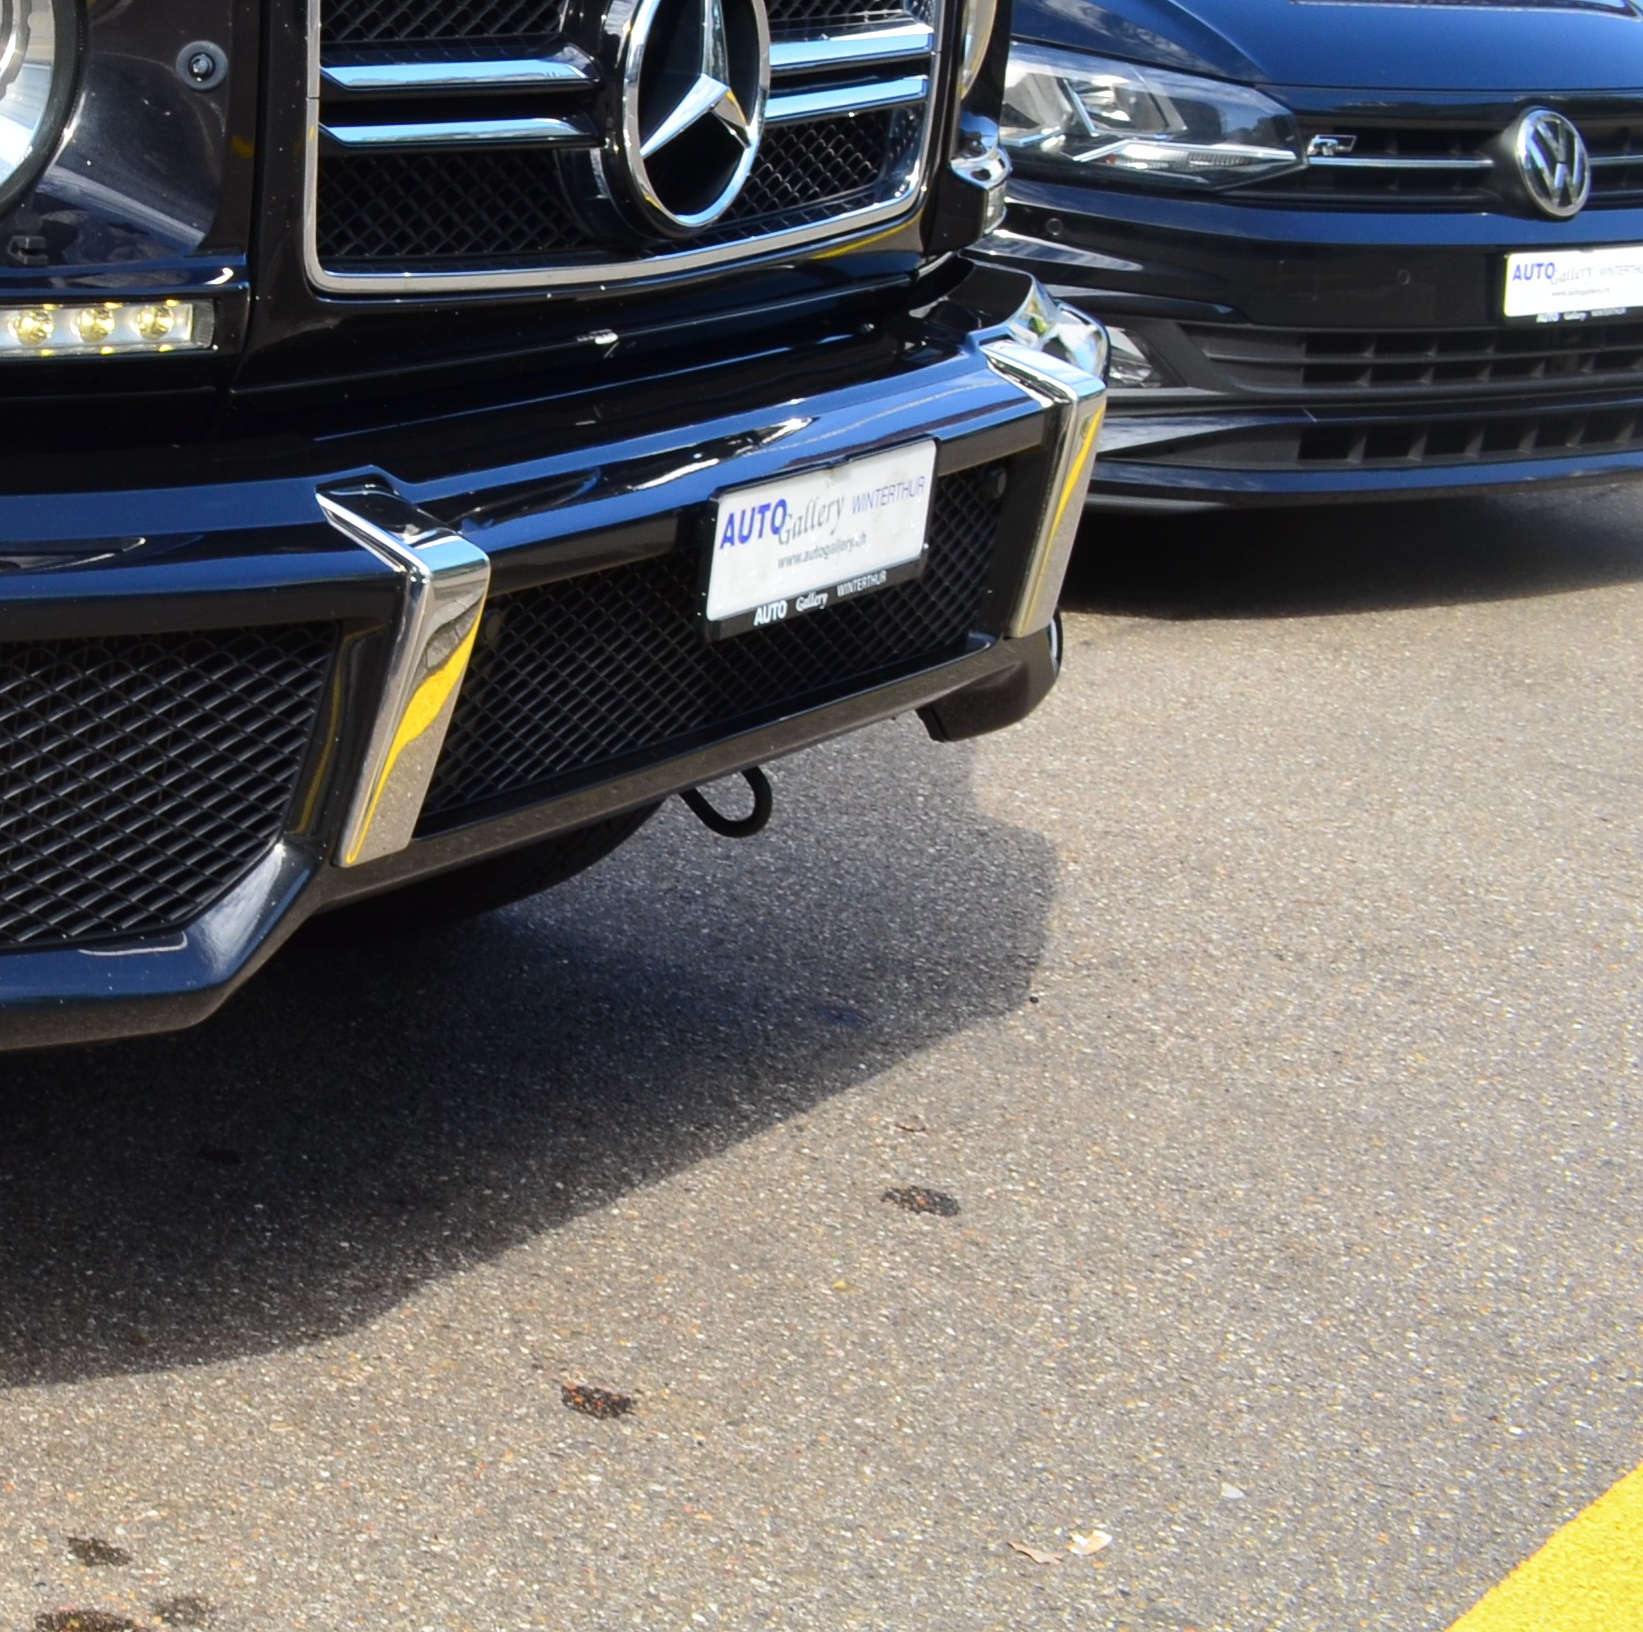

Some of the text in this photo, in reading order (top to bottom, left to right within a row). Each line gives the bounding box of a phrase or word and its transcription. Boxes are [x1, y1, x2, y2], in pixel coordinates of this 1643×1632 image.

[1512, 261, 1556, 282] AUTO
[719, 475, 926, 549] AUTO Gallery WINTERTHUR
[753, 571, 887, 626] AUTO Gallery WINTERTHUR
